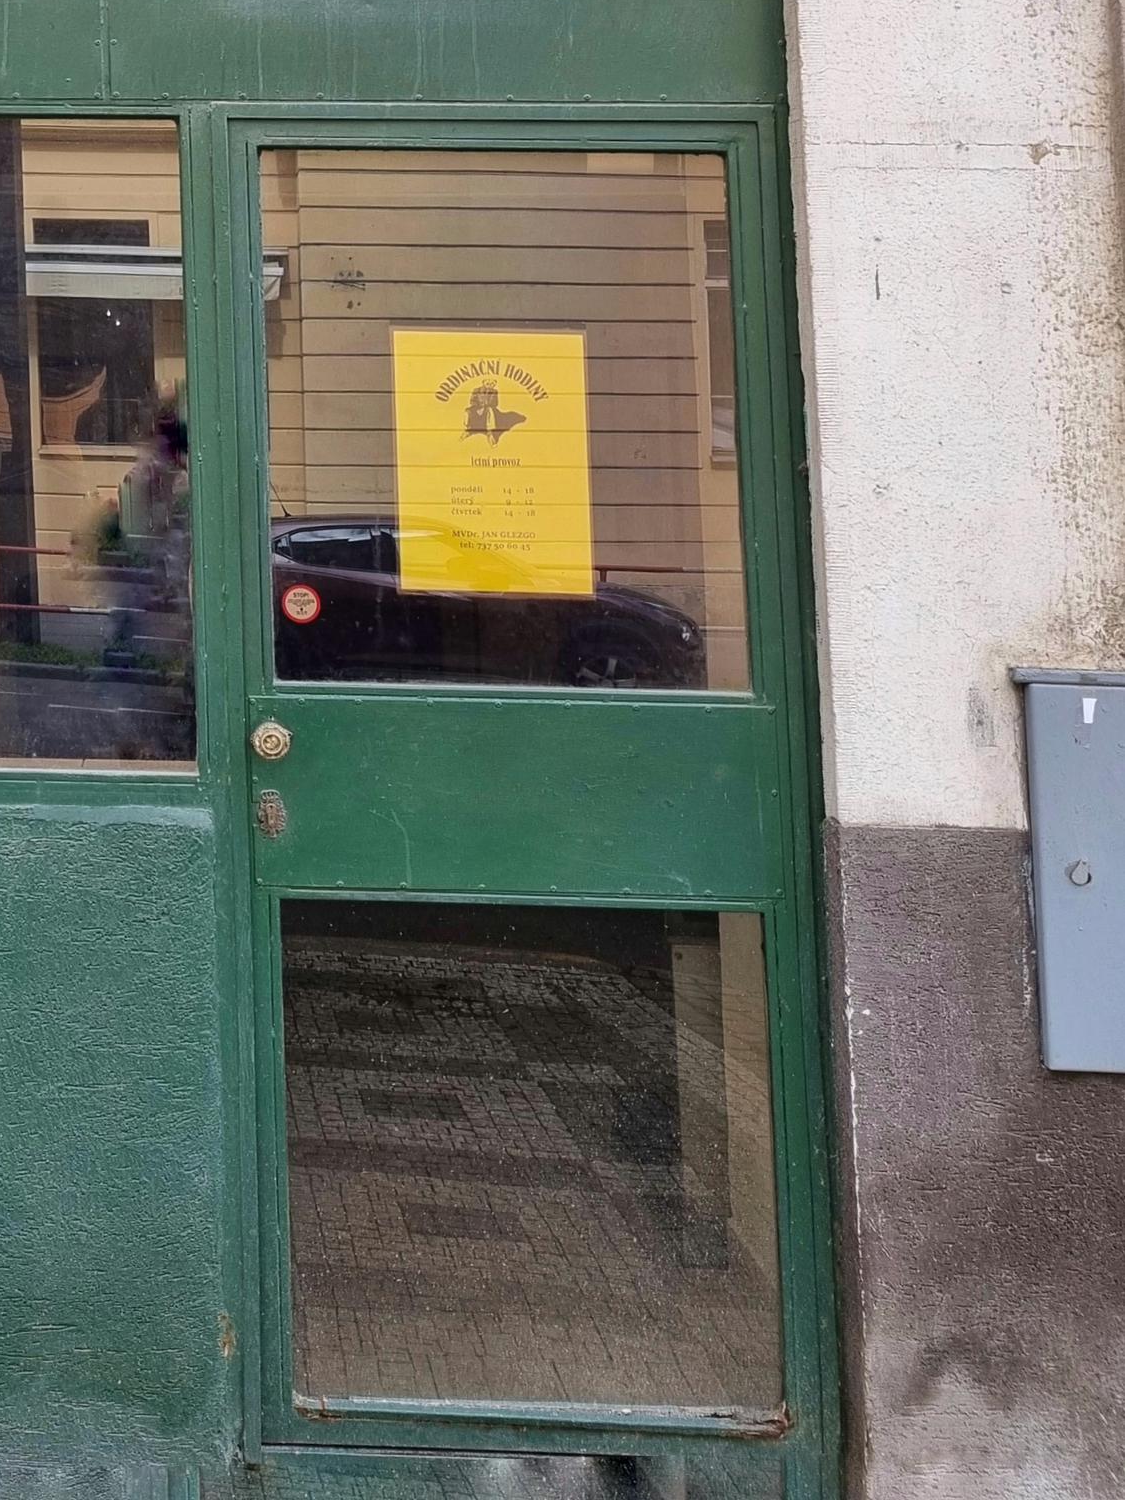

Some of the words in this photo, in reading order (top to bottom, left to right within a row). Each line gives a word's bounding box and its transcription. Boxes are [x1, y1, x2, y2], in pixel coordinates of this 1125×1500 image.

[434, 358, 501, 403] ORDINAČNÍ
[503, 363, 549, 403] HODINY
[492, 458, 522, 468] provoz
[451, 508, 482, 516] čtvrtek
[481, 531, 498, 540] JAN
